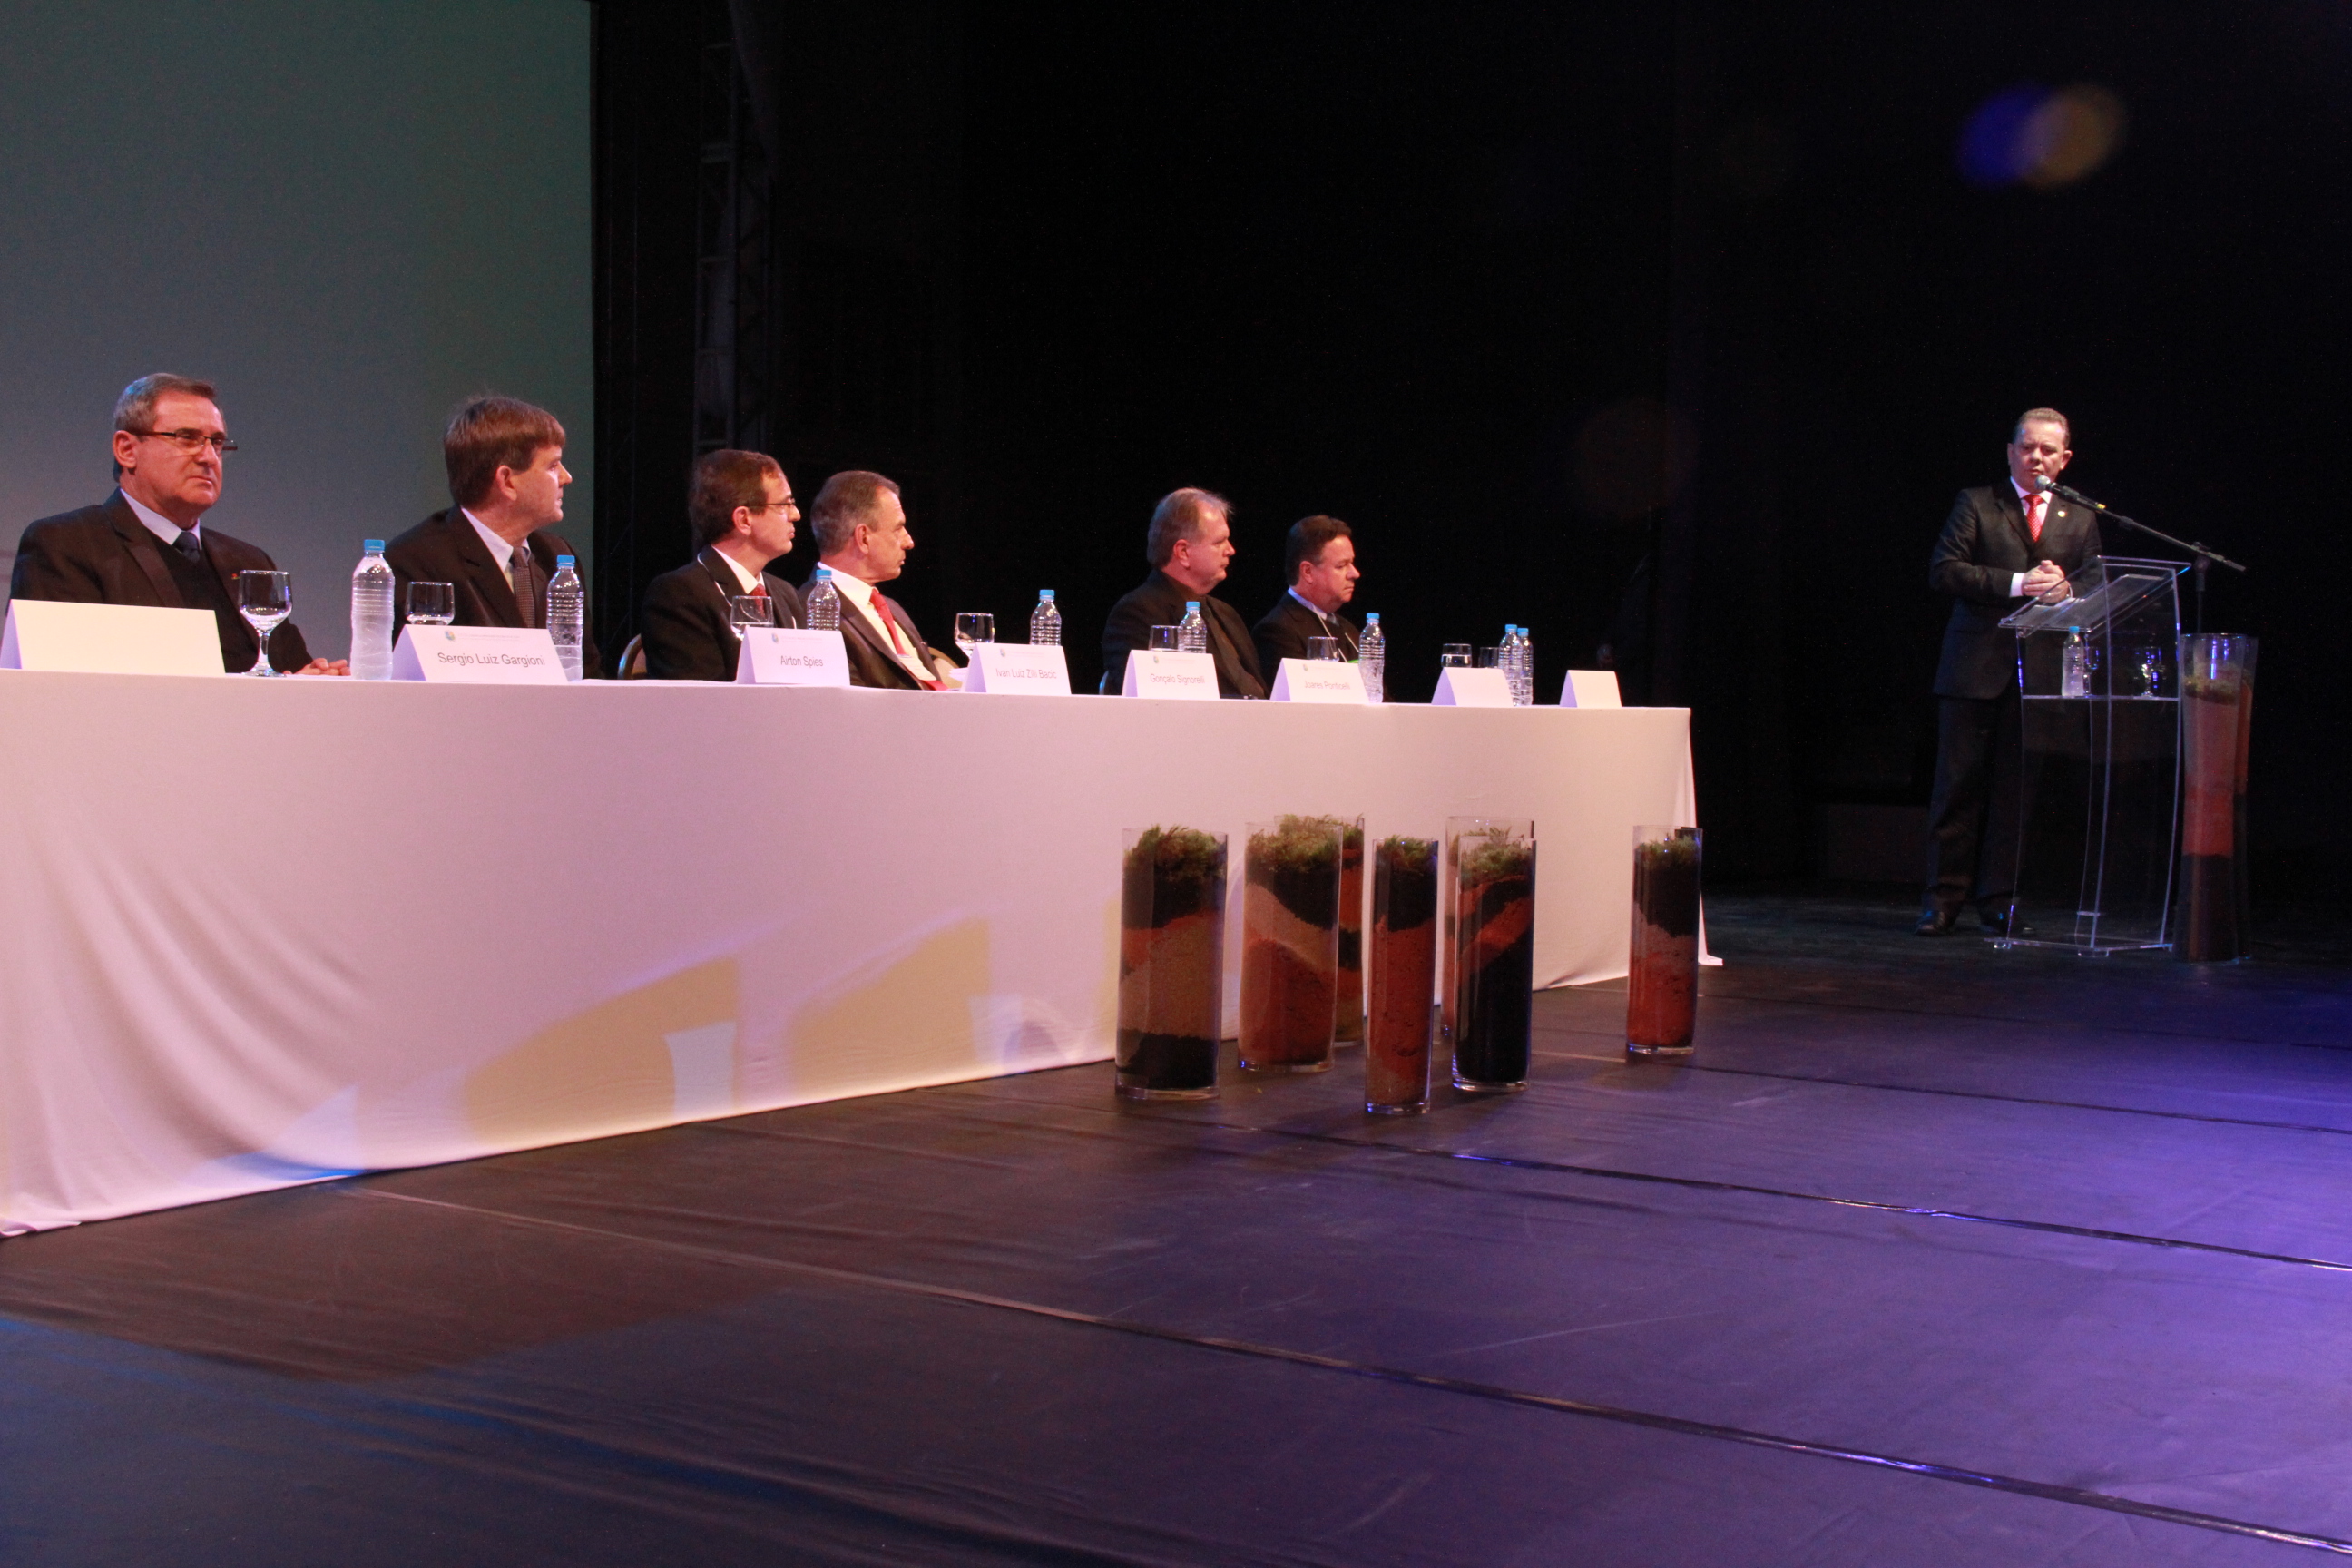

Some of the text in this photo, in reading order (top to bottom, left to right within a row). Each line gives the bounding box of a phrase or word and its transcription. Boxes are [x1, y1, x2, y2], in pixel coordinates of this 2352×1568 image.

[437, 652, 546, 668] Sergio Luiz Gargioni
[780, 655, 824, 668] Airton Spies
[995, 668, 1011, 677] Ivan
[1011, 668, 1025, 678] Luiz
[1150, 673, 1176, 685] Gonçalo
